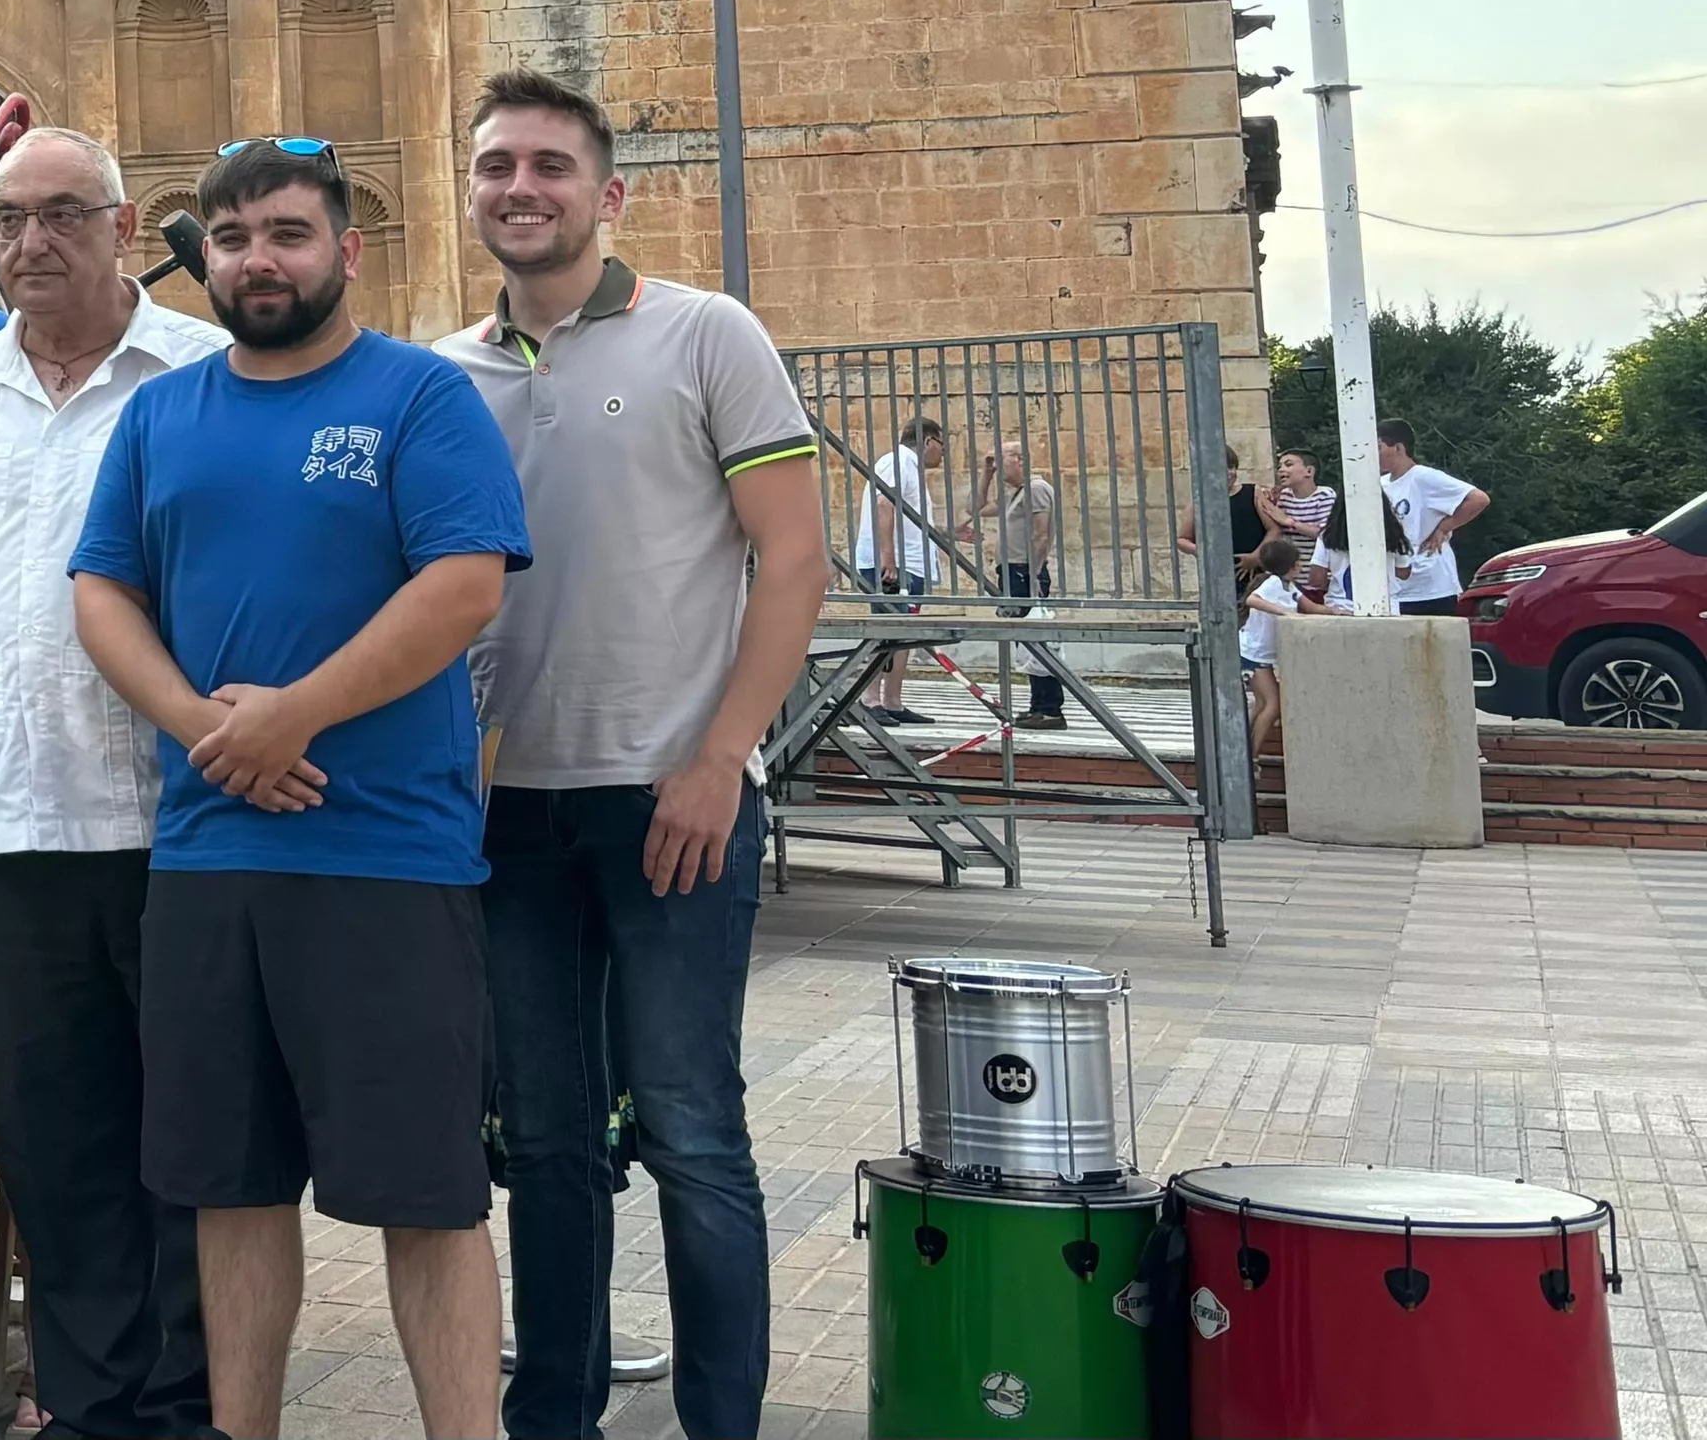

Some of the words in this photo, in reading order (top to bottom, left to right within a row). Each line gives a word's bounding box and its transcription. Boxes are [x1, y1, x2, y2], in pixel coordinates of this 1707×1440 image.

[311, 425, 382, 456] 寿司
[301, 452, 378, 487] タイム
